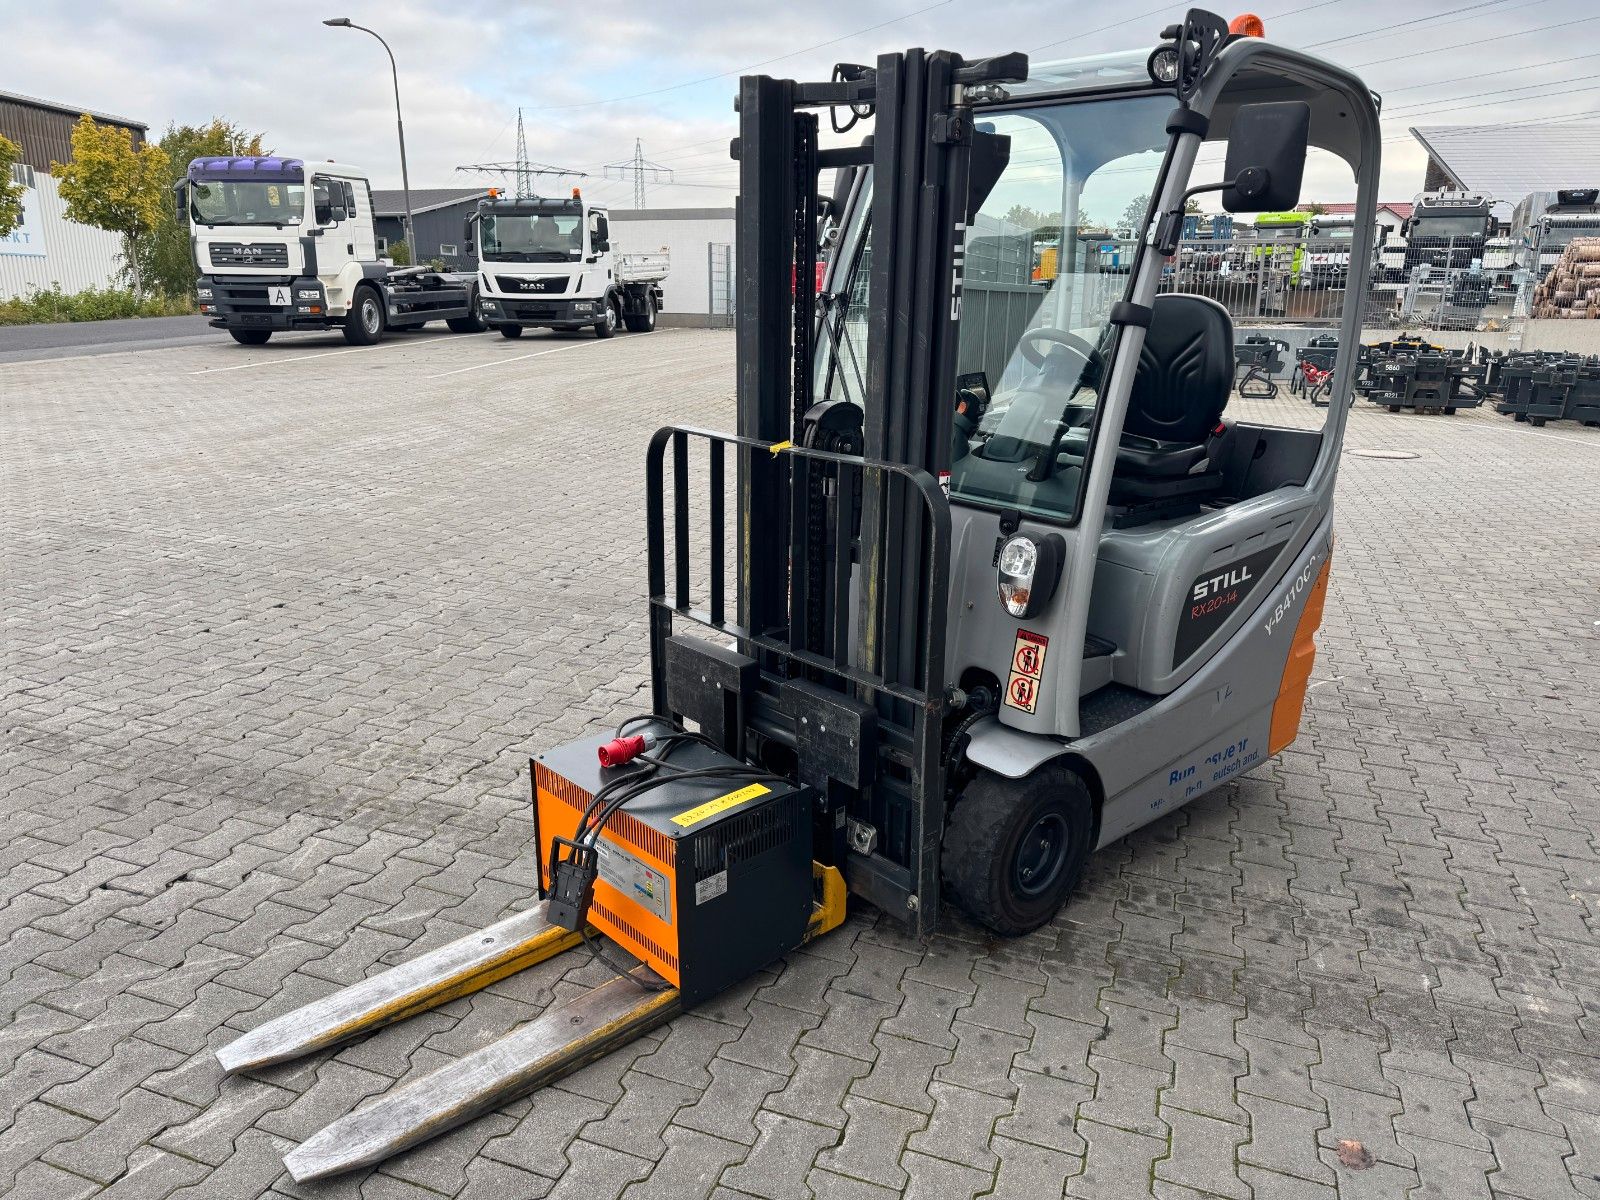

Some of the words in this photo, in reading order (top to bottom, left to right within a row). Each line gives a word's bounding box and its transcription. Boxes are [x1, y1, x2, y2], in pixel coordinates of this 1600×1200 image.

[233, 247, 262, 255] MAN
[276, 289, 286, 303] A
[1193, 566, 1252, 601] STILL
[1191, 589, 1238, 620] RX20-14
